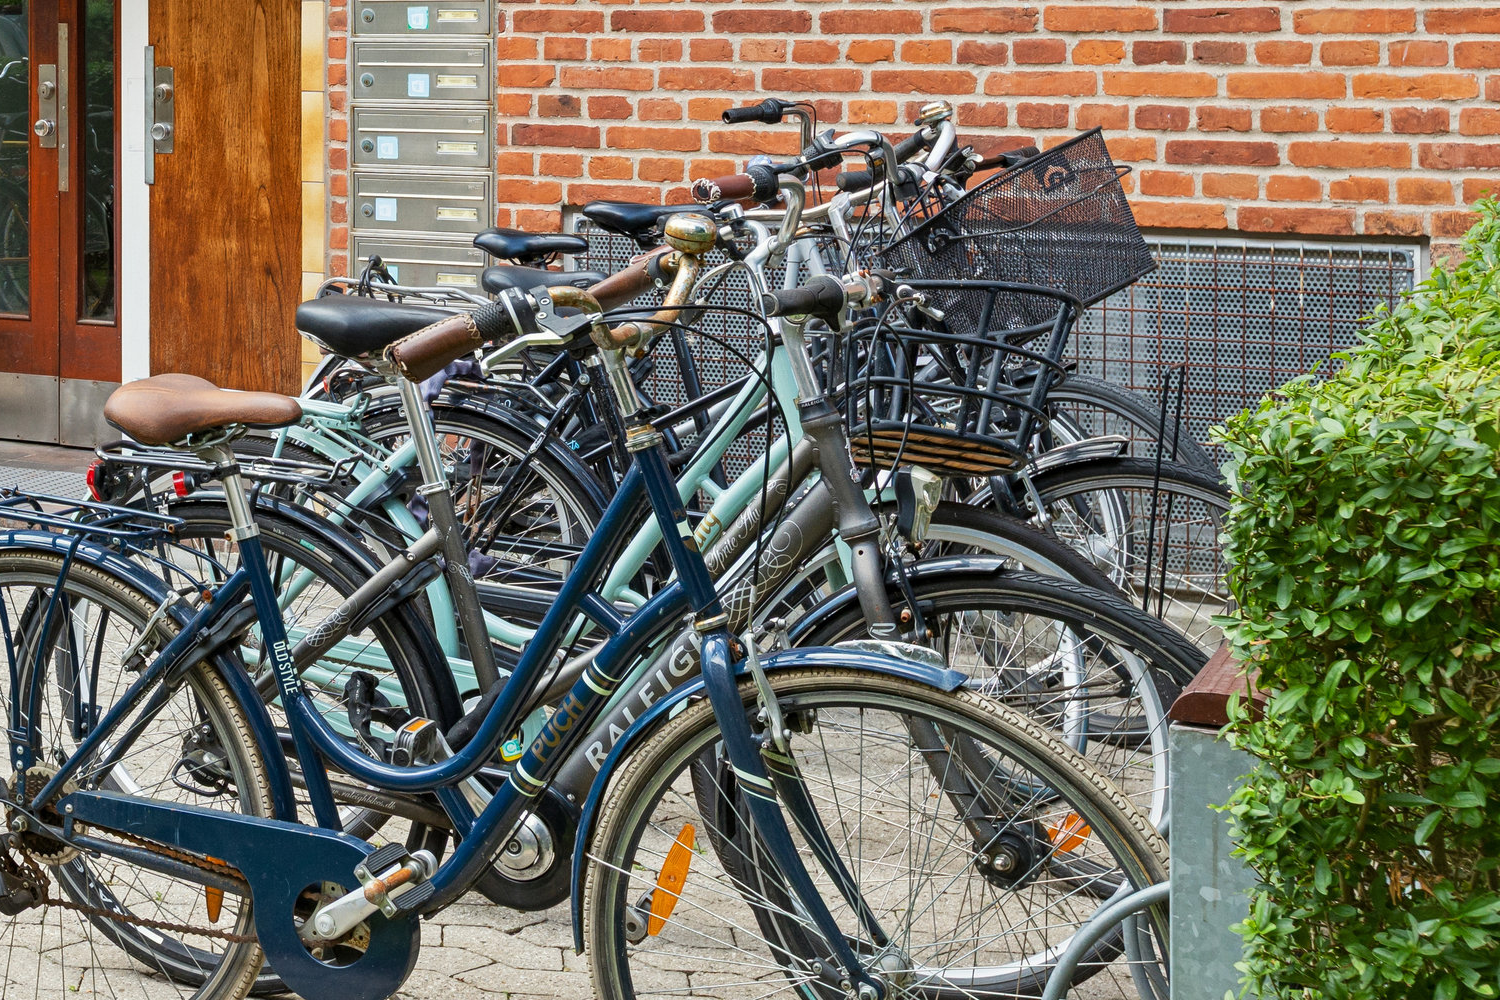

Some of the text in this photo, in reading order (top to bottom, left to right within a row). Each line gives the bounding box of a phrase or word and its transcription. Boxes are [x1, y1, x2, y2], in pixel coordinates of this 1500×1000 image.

[704, 537, 738, 575] Sprite
[273, 640, 298, 696] OLD STYLE
[531, 692, 585, 763] PUCH
